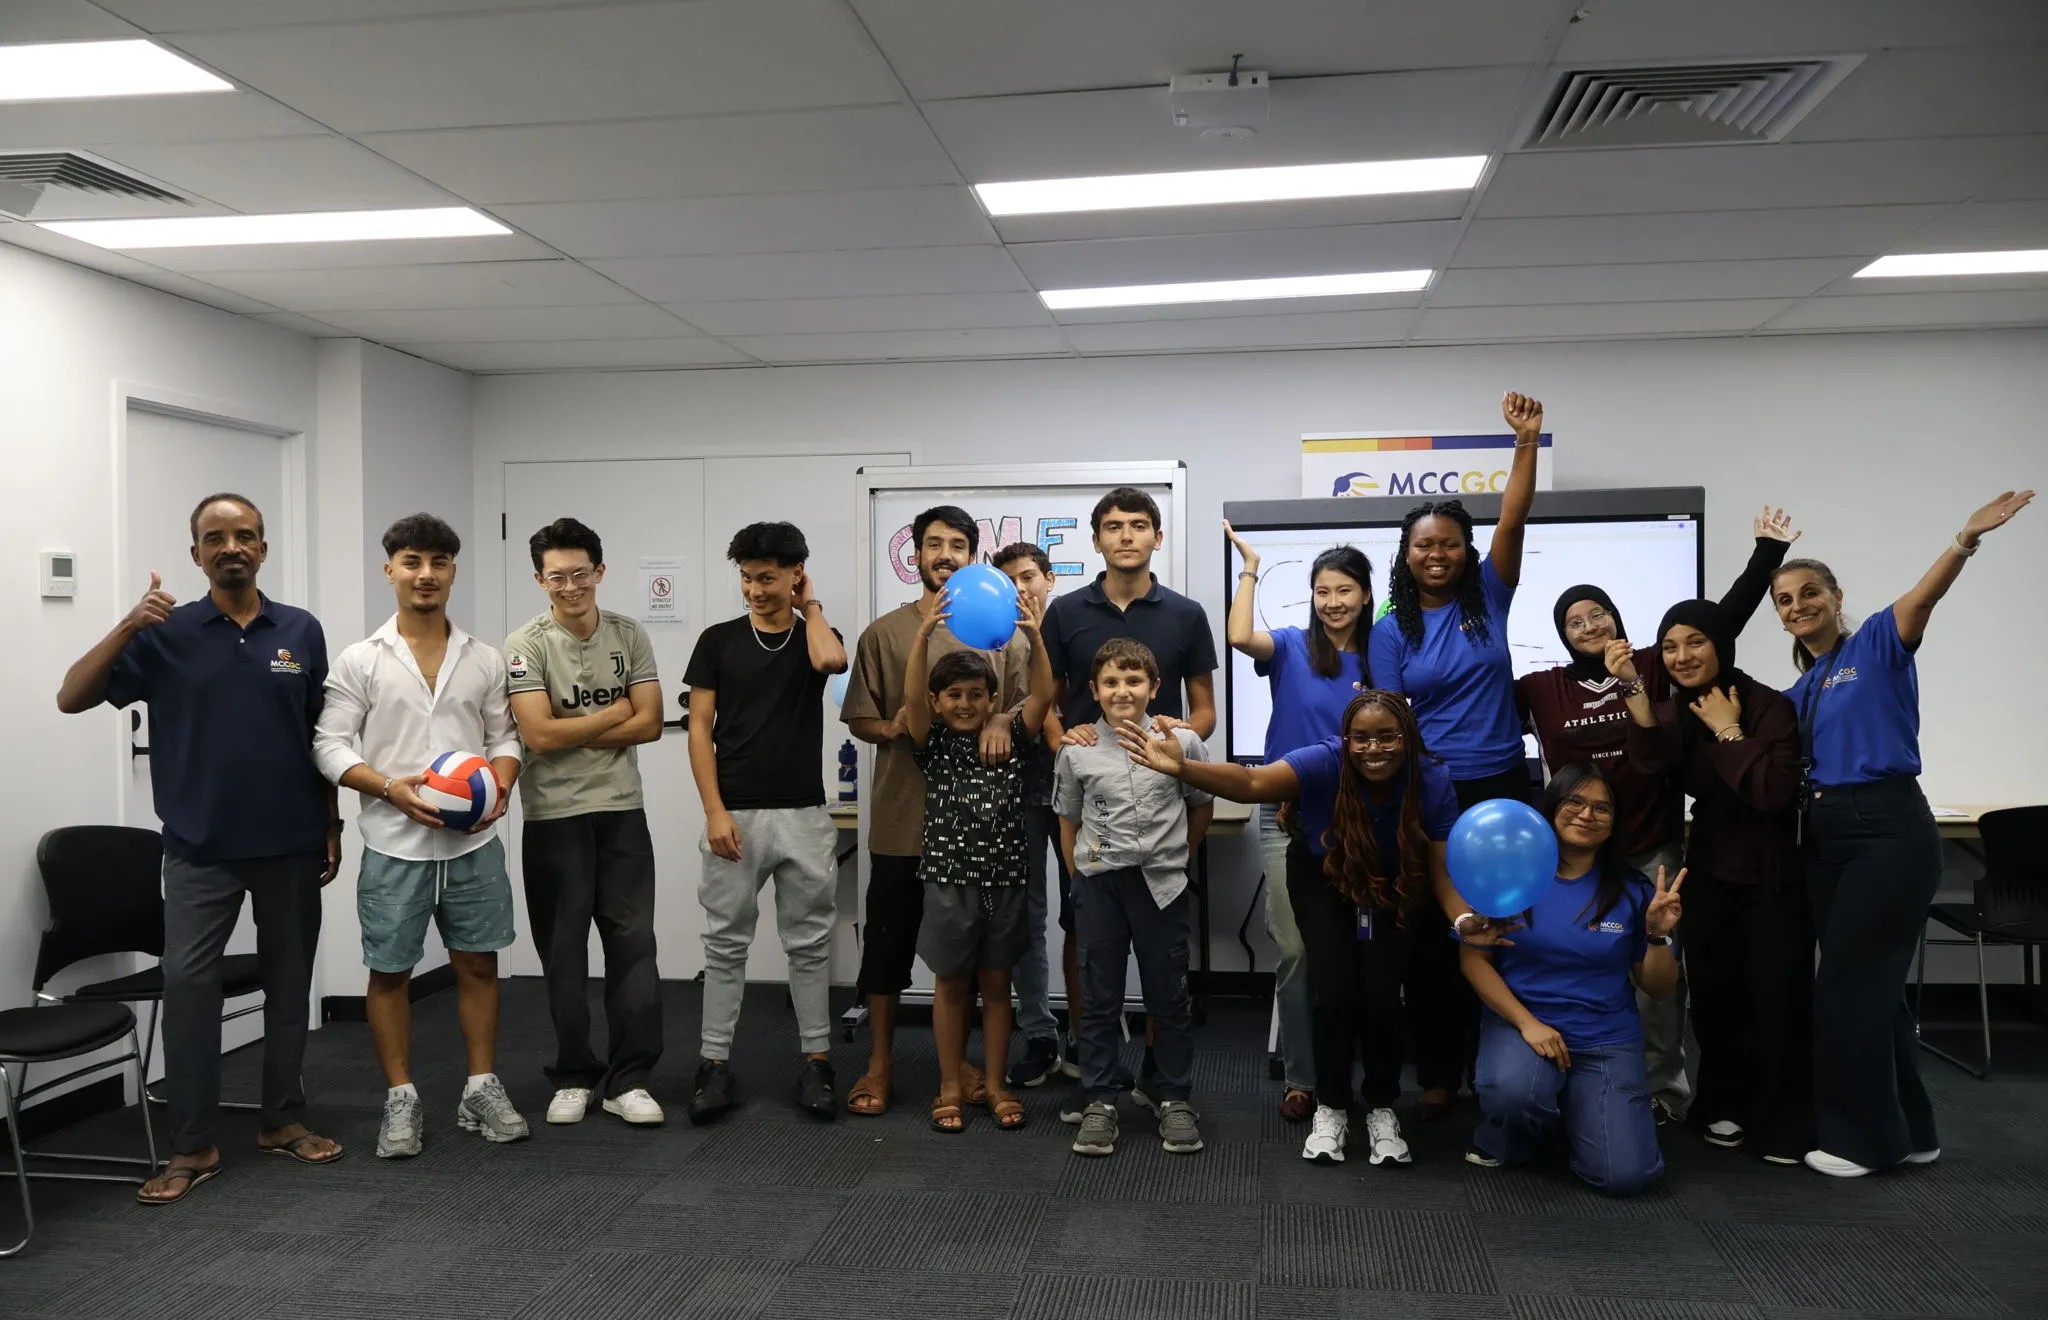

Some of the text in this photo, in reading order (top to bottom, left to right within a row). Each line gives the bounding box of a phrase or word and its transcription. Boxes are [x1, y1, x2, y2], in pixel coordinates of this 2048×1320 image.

[1388, 471, 1508, 496] MCCGC
[889, 516, 1084, 585] GME
[270, 660, 301, 670] MCCGC
[1564, 711, 1628, 728] ATHLETIC
